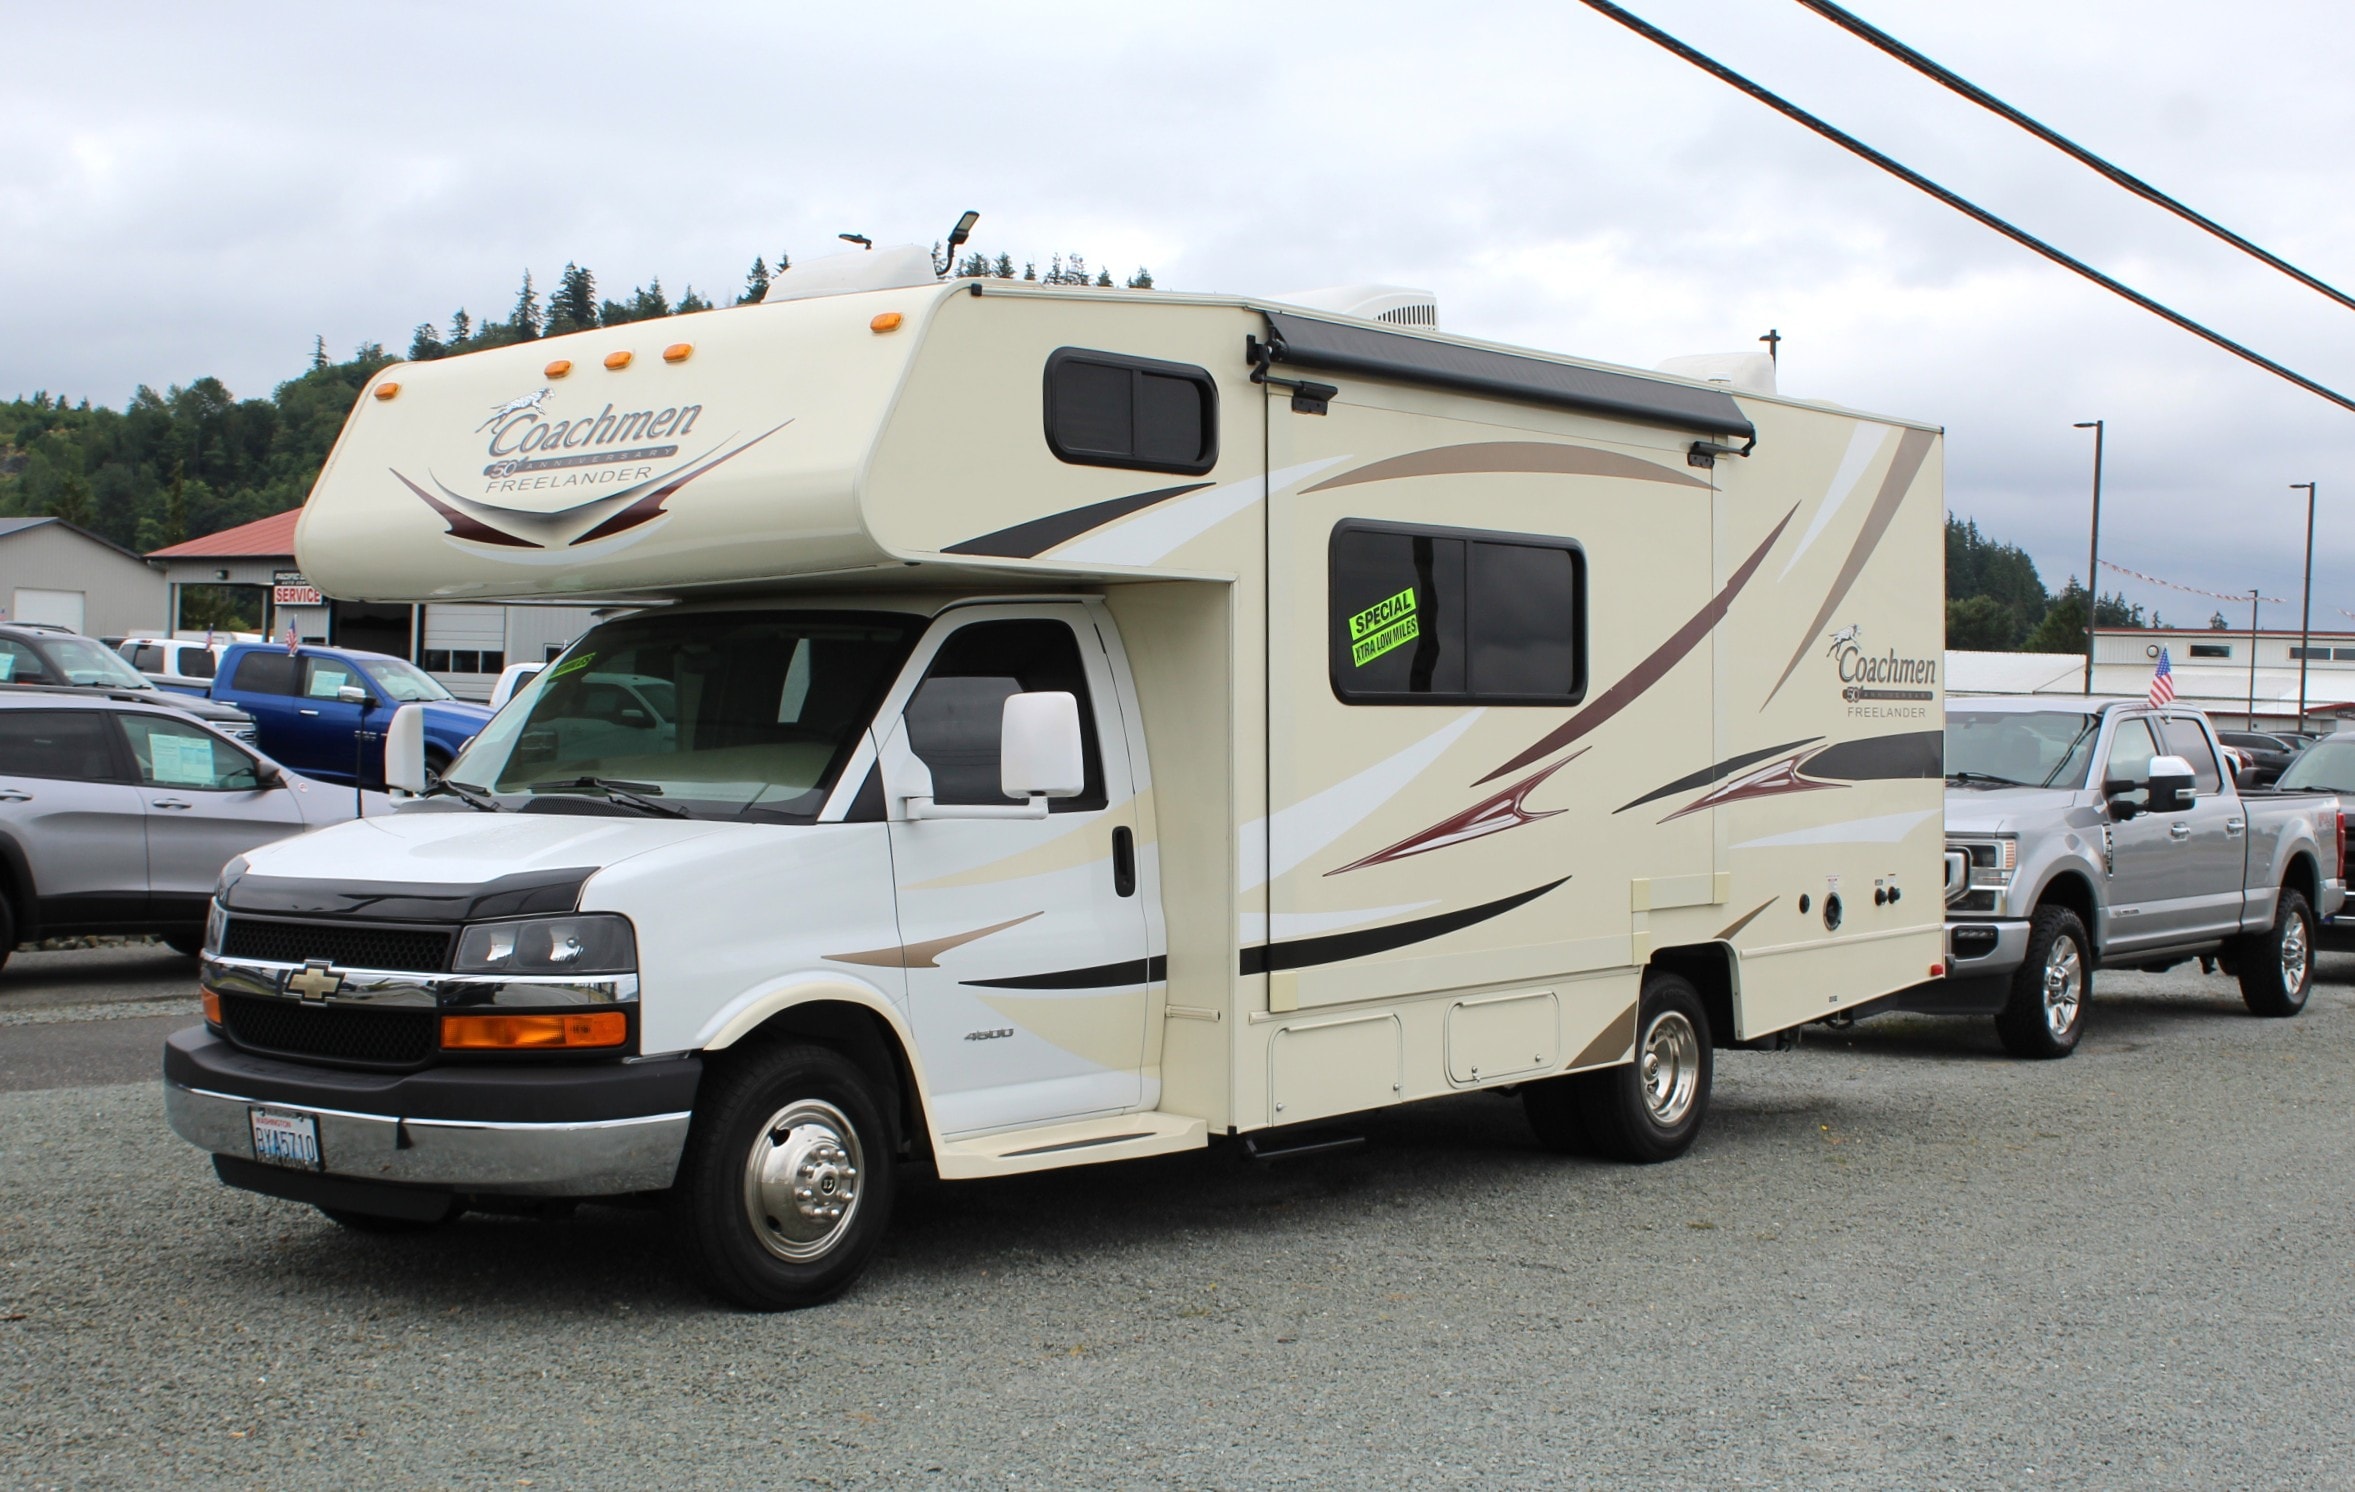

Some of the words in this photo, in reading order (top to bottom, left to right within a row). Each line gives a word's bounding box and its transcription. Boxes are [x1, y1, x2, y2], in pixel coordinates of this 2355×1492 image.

[488, 403, 703, 457] Coachmen
[525, 447, 674, 470] ANNIVERSARY
[485, 466, 653, 494] FREELANDER
[276, 588, 320, 602] SERVICE
[1355, 593, 1411, 634] SPECIAL
[1355, 639, 1376, 663] XTRA
[1376, 629, 1392, 651] LOW
[1393, 617, 1416, 643] MILES
[1839, 647, 1936, 684] Coachmen
[1847, 706, 1926, 718] FREELANDER
